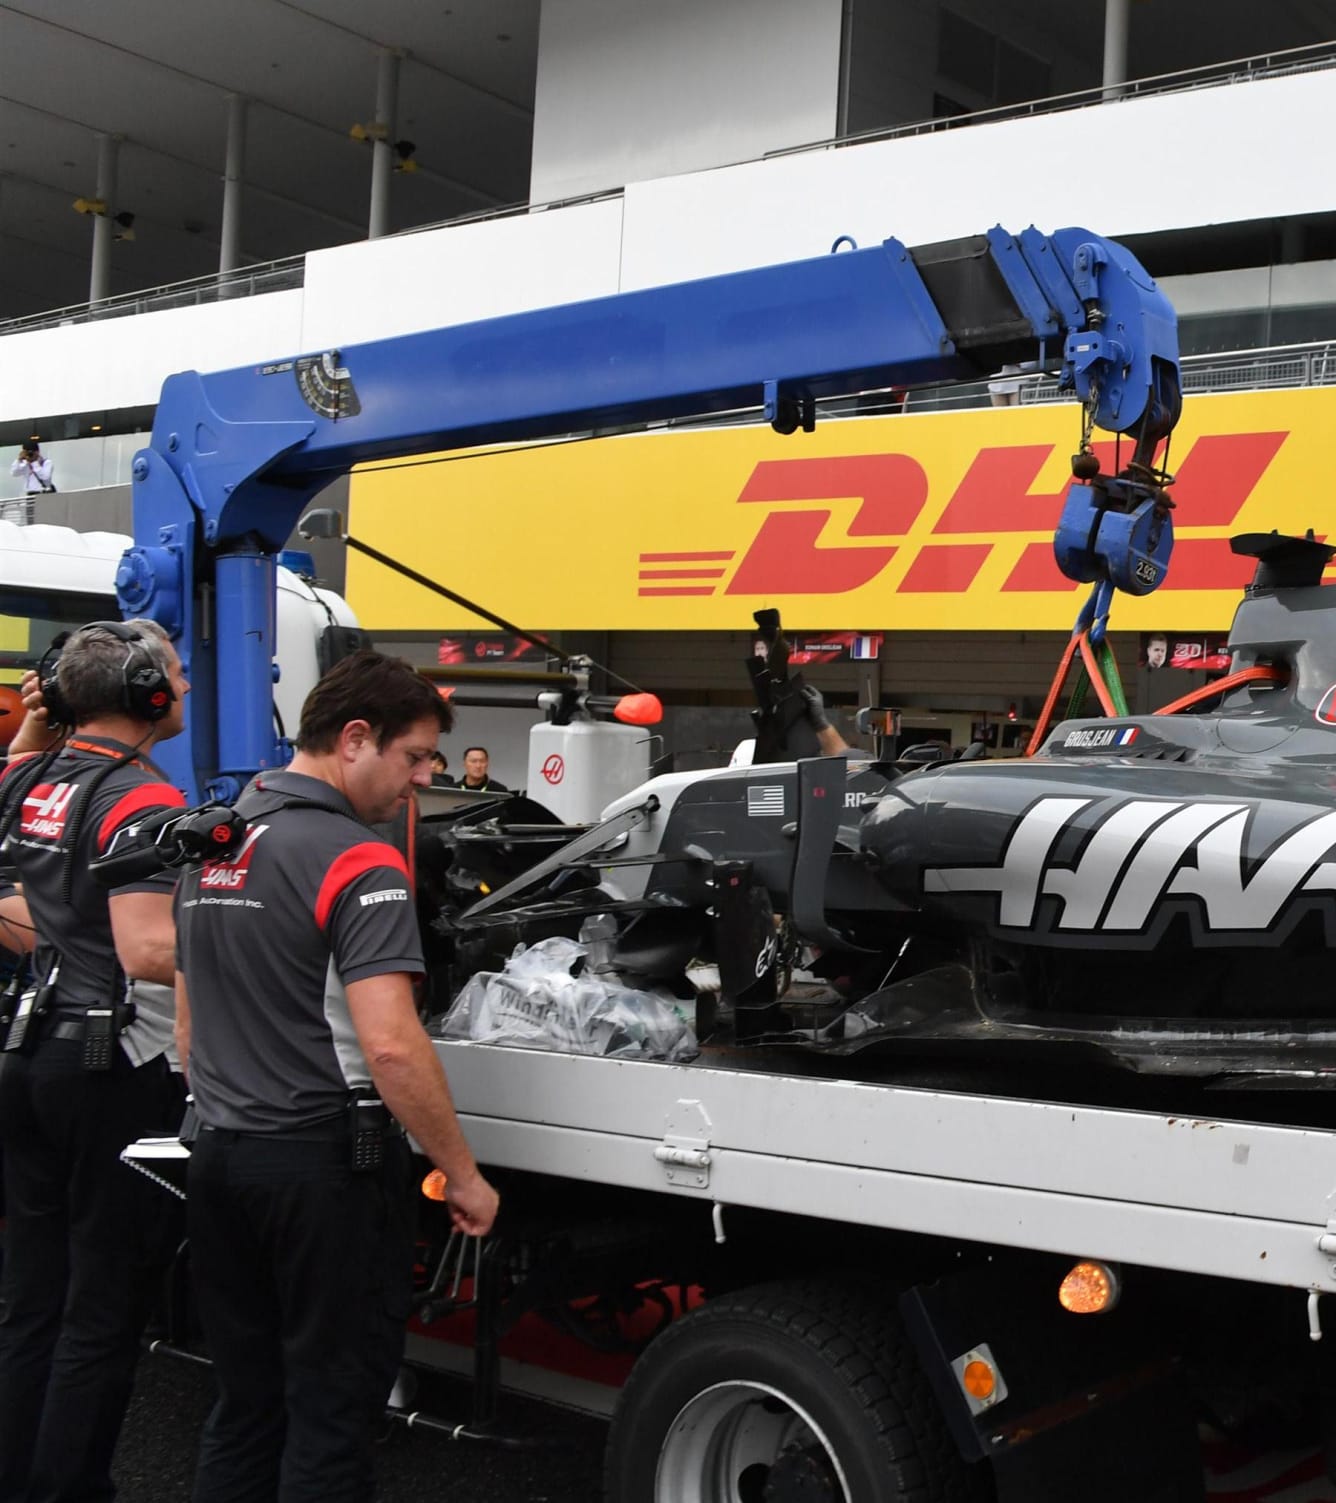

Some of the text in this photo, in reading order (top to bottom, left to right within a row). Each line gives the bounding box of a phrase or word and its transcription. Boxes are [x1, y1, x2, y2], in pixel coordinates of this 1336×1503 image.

[724, 431, 1291, 596] DHL
[1064, 729, 1117, 747] GROSJEAN
[245, 900, 265, 909] Inc.
[359, 888, 407, 907] PIRELLI
